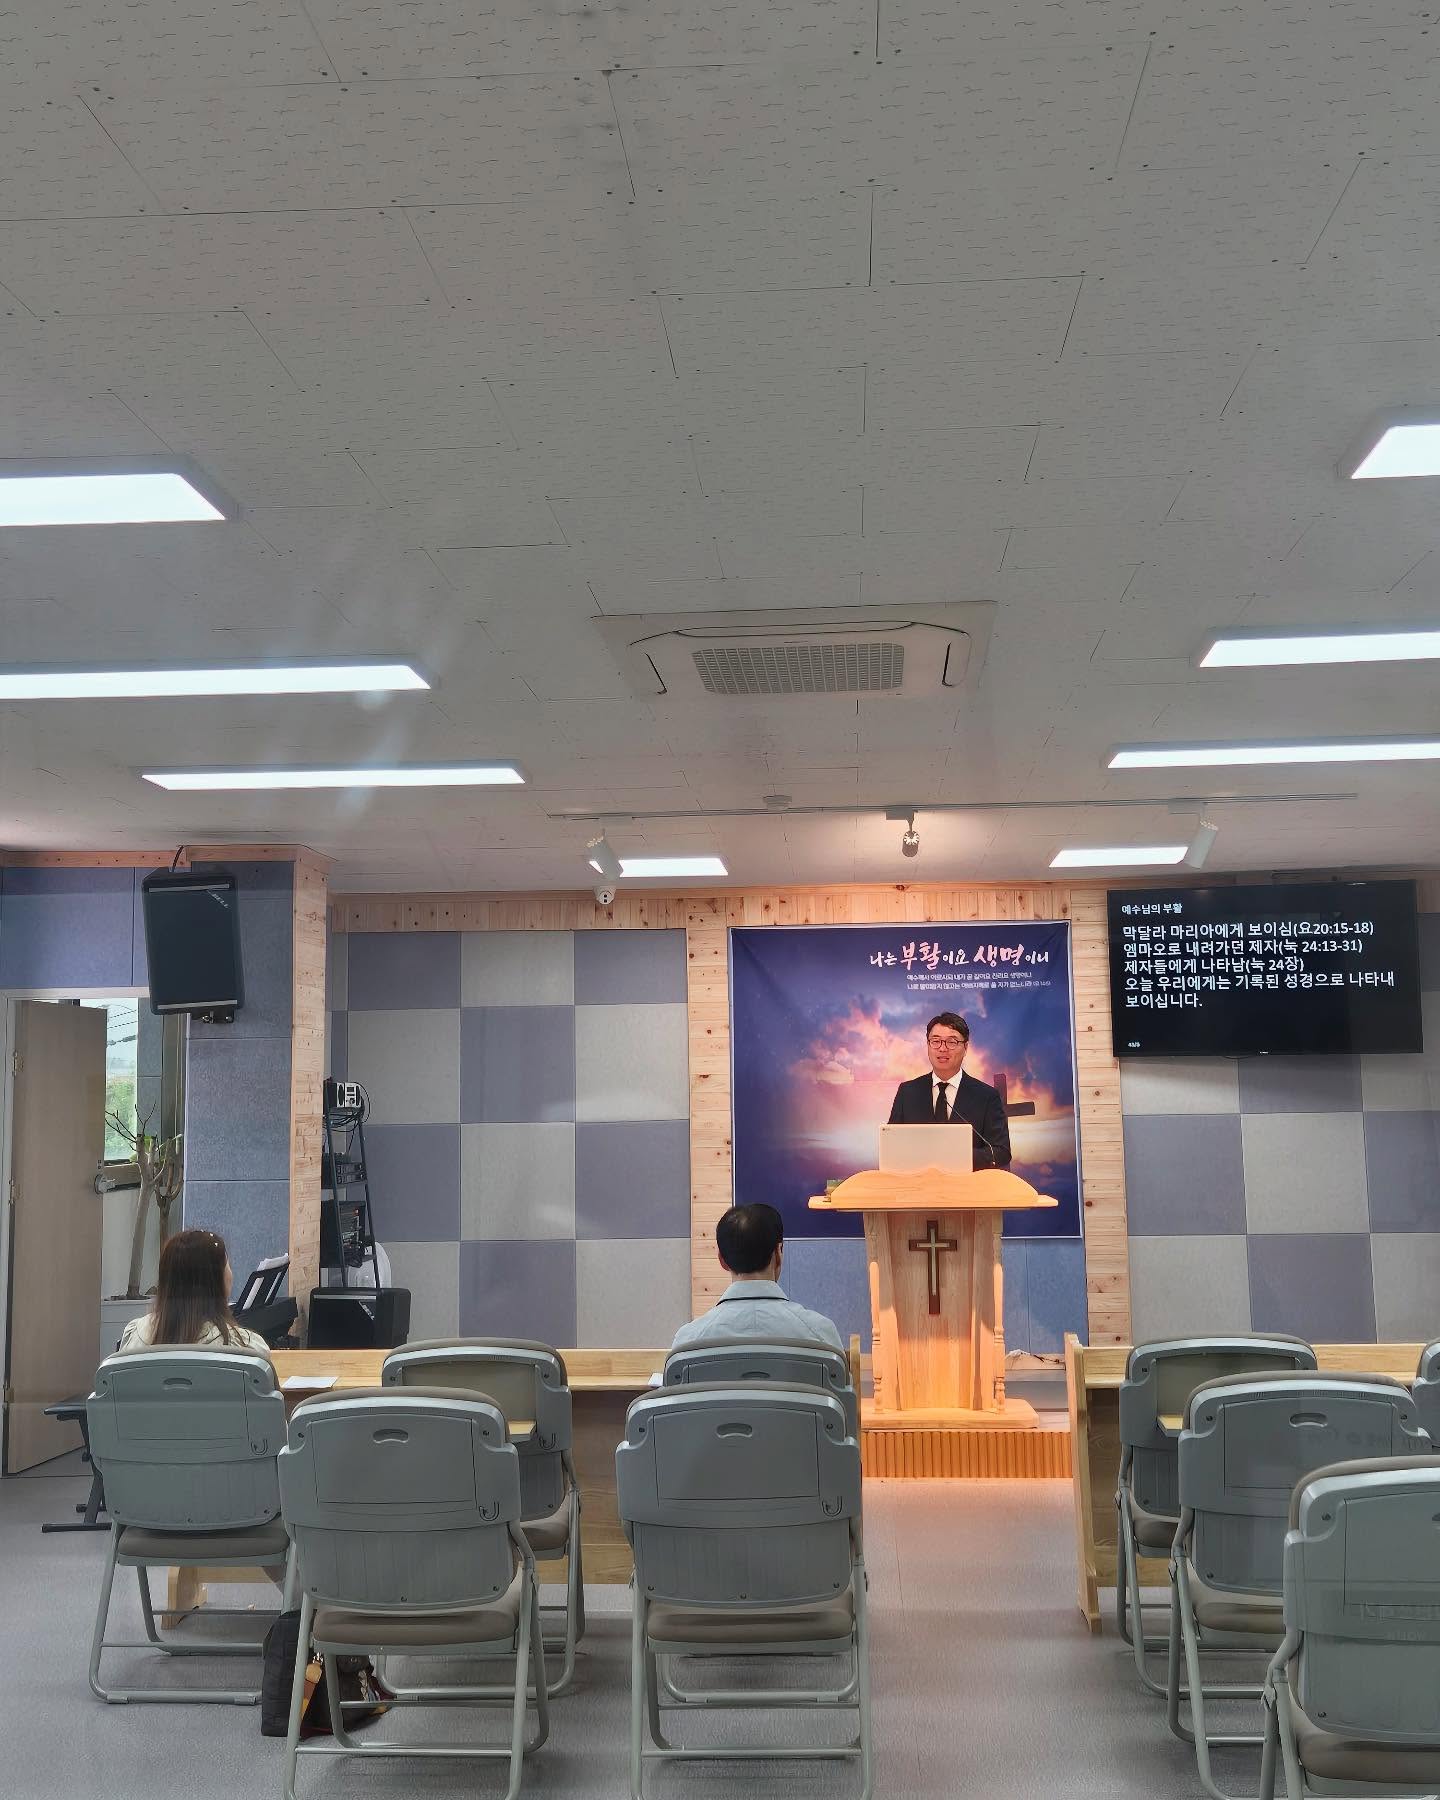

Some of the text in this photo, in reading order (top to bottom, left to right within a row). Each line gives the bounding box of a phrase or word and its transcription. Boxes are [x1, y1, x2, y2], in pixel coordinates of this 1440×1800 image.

[1122, 903, 1182, 915] 예수님의 부활
[1123, 921, 1373, 940] 막달라 마리아에게 보이심(요20:15-18)
[870, 942, 1048, 970] 나는 부활이요 생명이니
[1124, 939, 1362, 957] 엠마오로 내려가던 제자(눅 24:13-31)
[1125, 956, 1304, 974] 제자들에게 나타남(눅 24장)
[1125, 971, 1394, 991] 오늘 우리에게는 기록된 성경으로 나타내
[1126, 993, 1202, 1008] 보이십니다.
